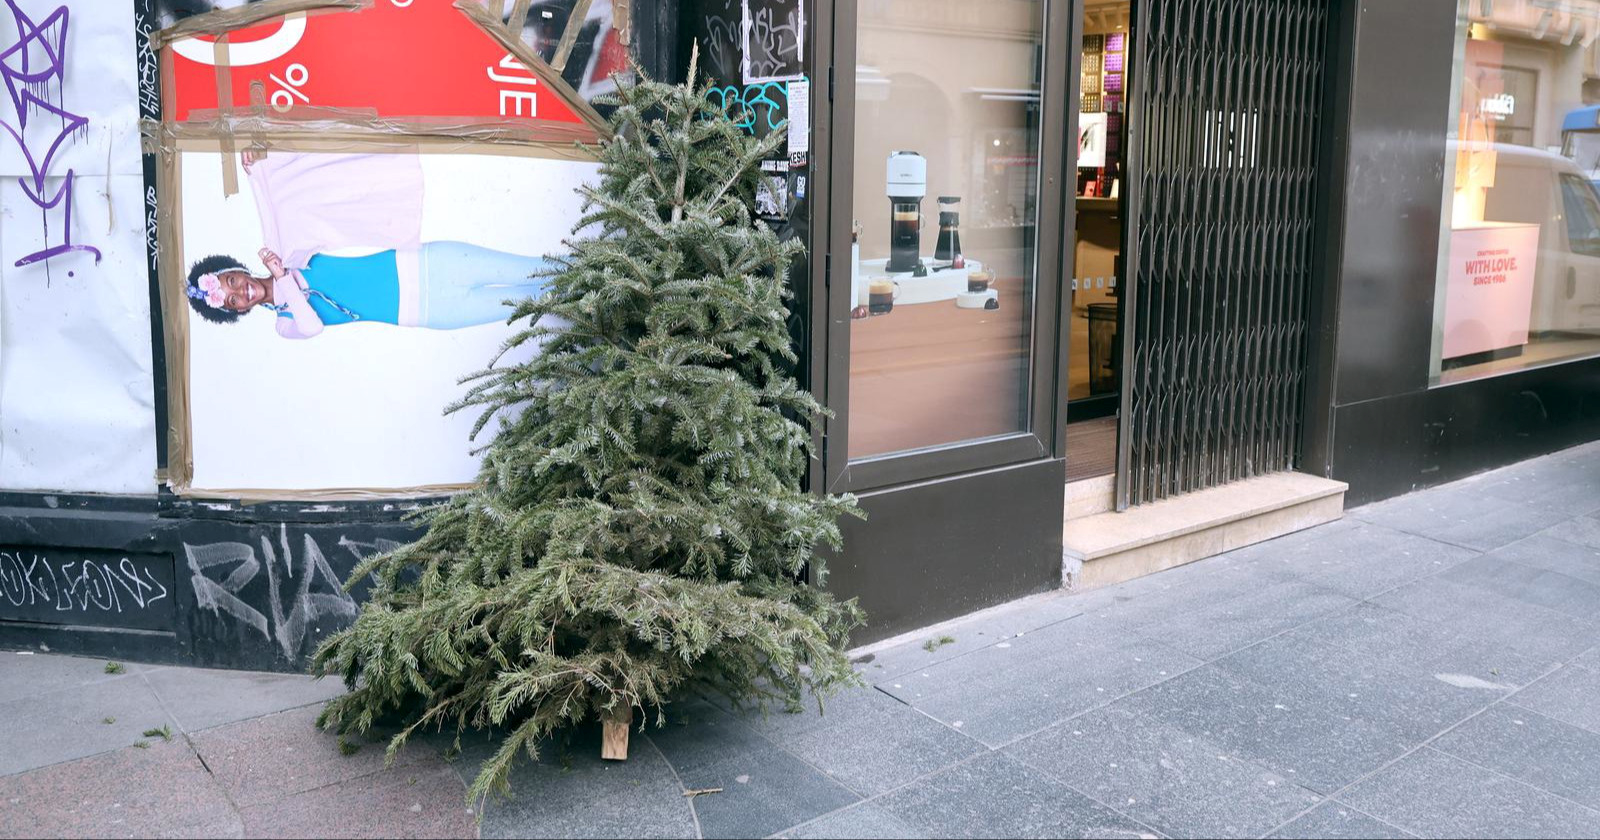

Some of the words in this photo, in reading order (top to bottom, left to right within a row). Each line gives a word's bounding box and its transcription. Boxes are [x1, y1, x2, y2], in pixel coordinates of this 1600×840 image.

[1465, 259, 1491, 275] WITH
[1492, 257, 1518, 273] LOVE.
[1473, 275, 1492, 286] SINCE
